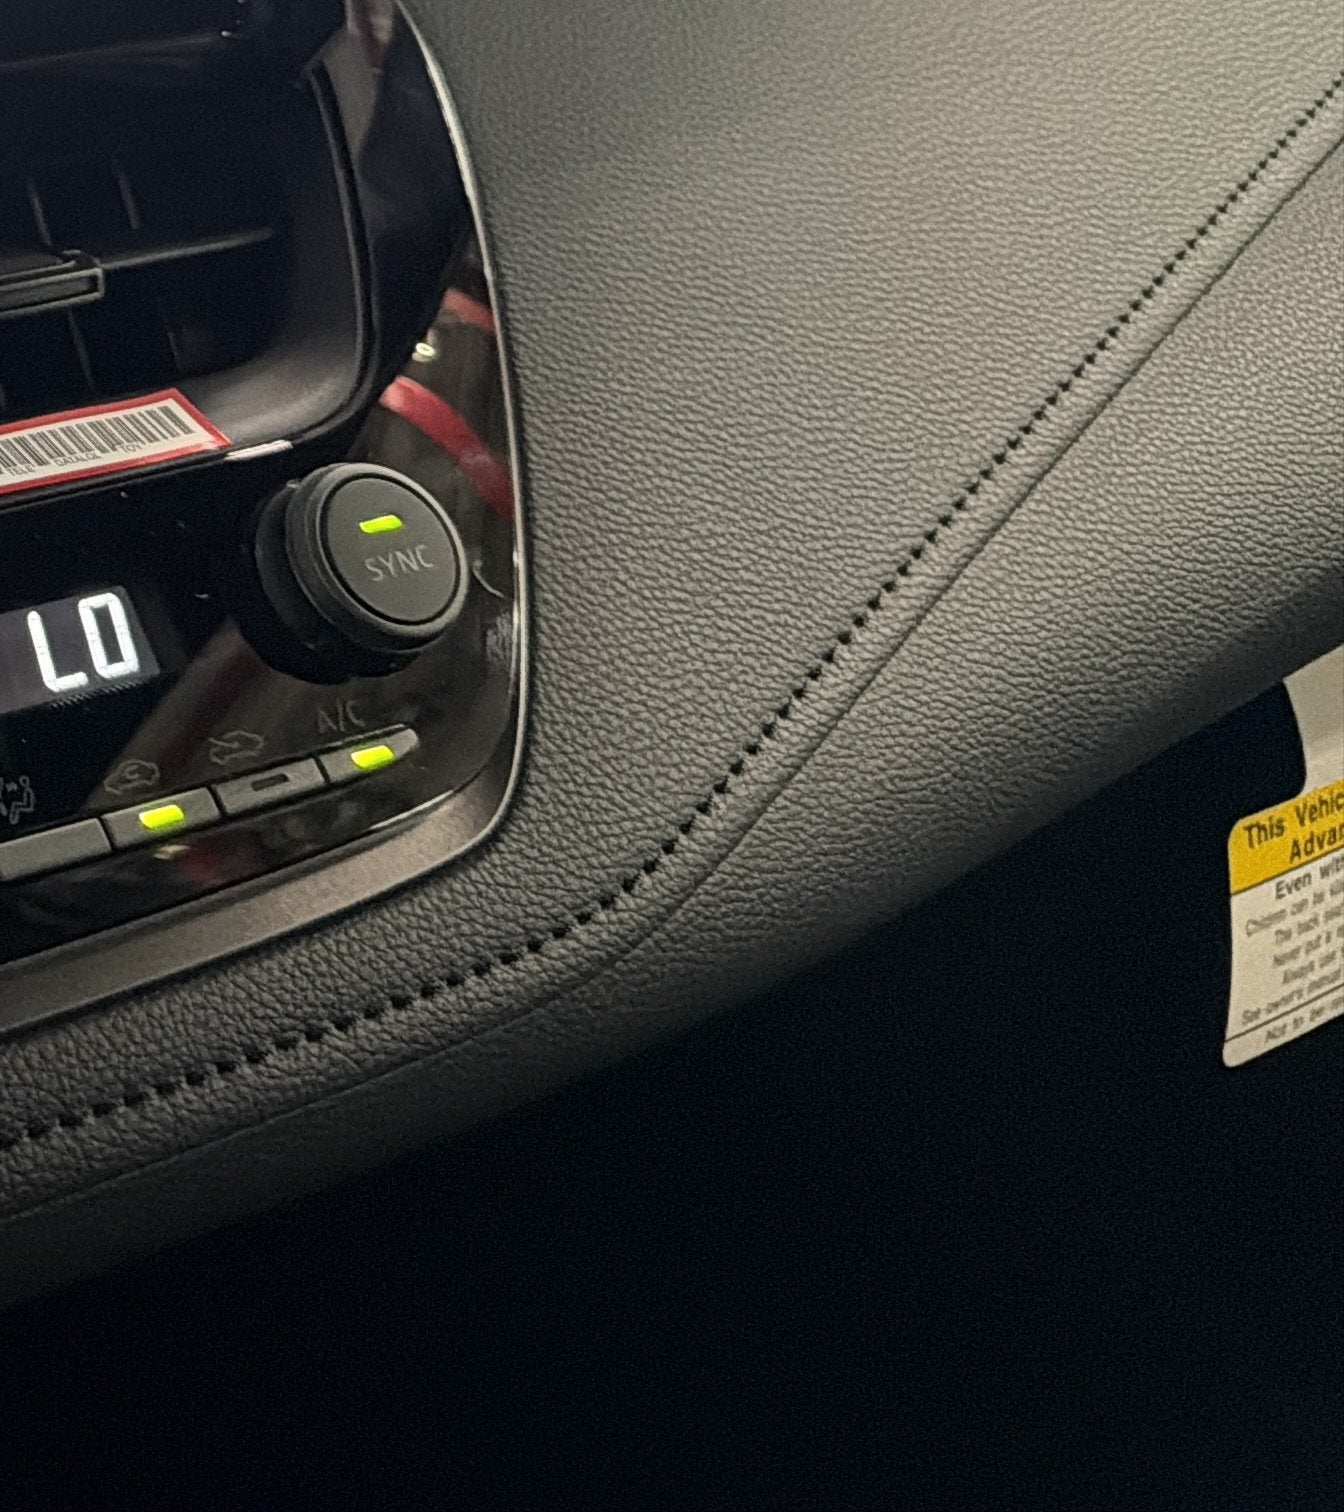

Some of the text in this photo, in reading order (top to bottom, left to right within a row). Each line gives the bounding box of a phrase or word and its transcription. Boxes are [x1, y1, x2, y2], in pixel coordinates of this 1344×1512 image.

[364, 543, 434, 584] SYNC
[316, 696, 367, 735] A/C
[1243, 816, 1287, 850] This
[1274, 871, 1313, 901] Even
